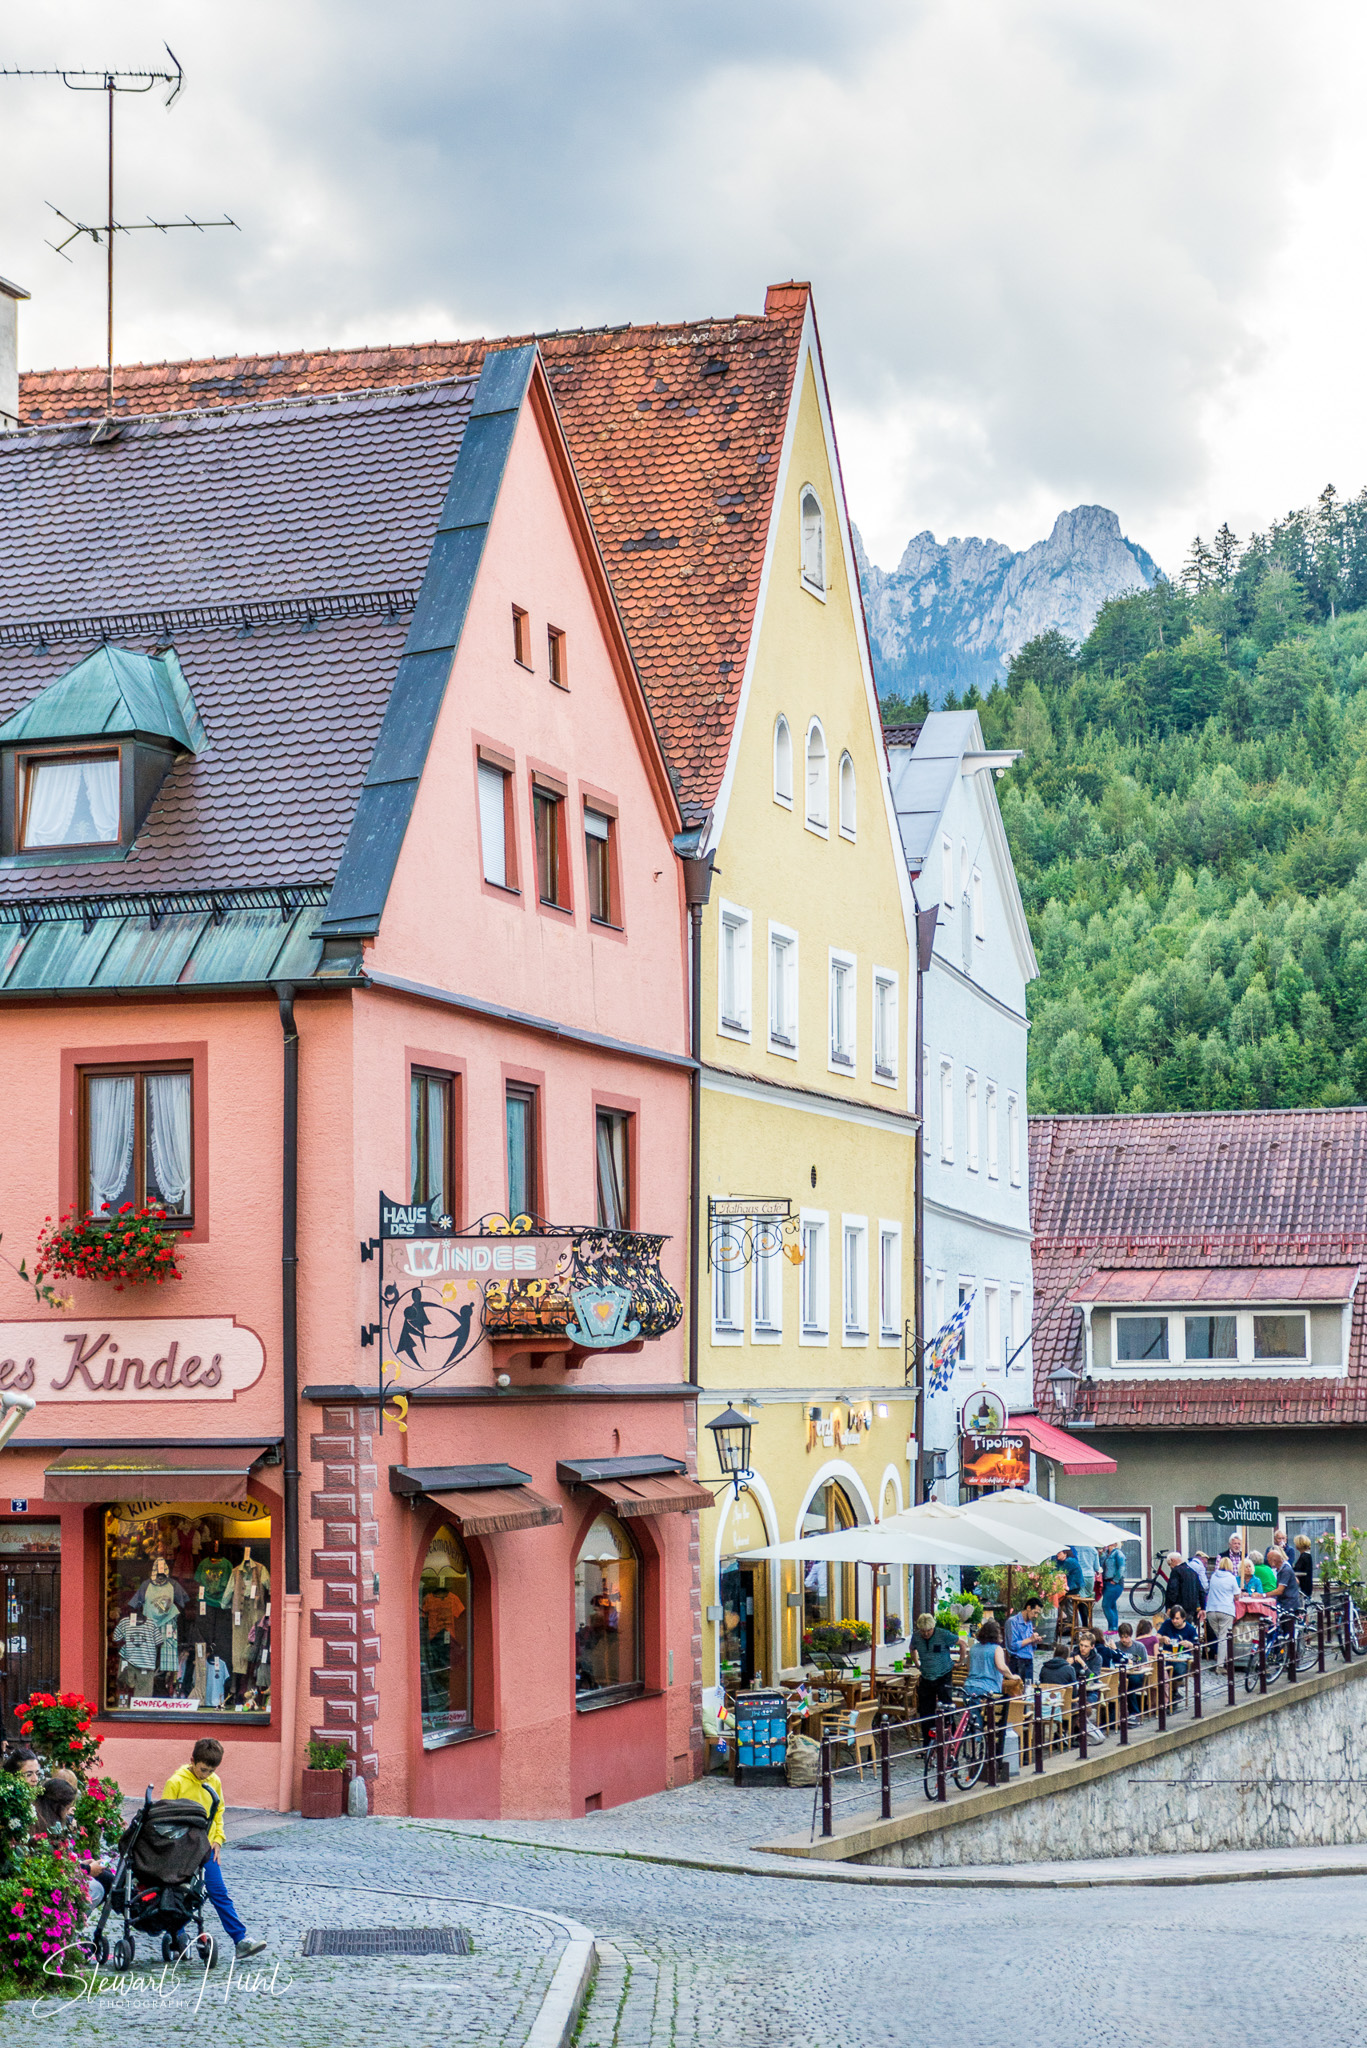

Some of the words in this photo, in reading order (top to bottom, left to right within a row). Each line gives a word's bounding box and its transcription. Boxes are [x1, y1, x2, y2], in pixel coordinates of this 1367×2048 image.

[383, 1206, 427, 1224] HAUS
[719, 1202, 759, 1214] Rathaus
[390, 1223, 415, 1235] DES
[50, 1332, 222, 1390] Kindes
[971, 1436, 1024, 1450] Tipolino
[16, 1502, 23, 1511] 2
[1234, 1497, 1260, 1511] Wein
[1218, 1505, 1273, 1522] Spirituosen
